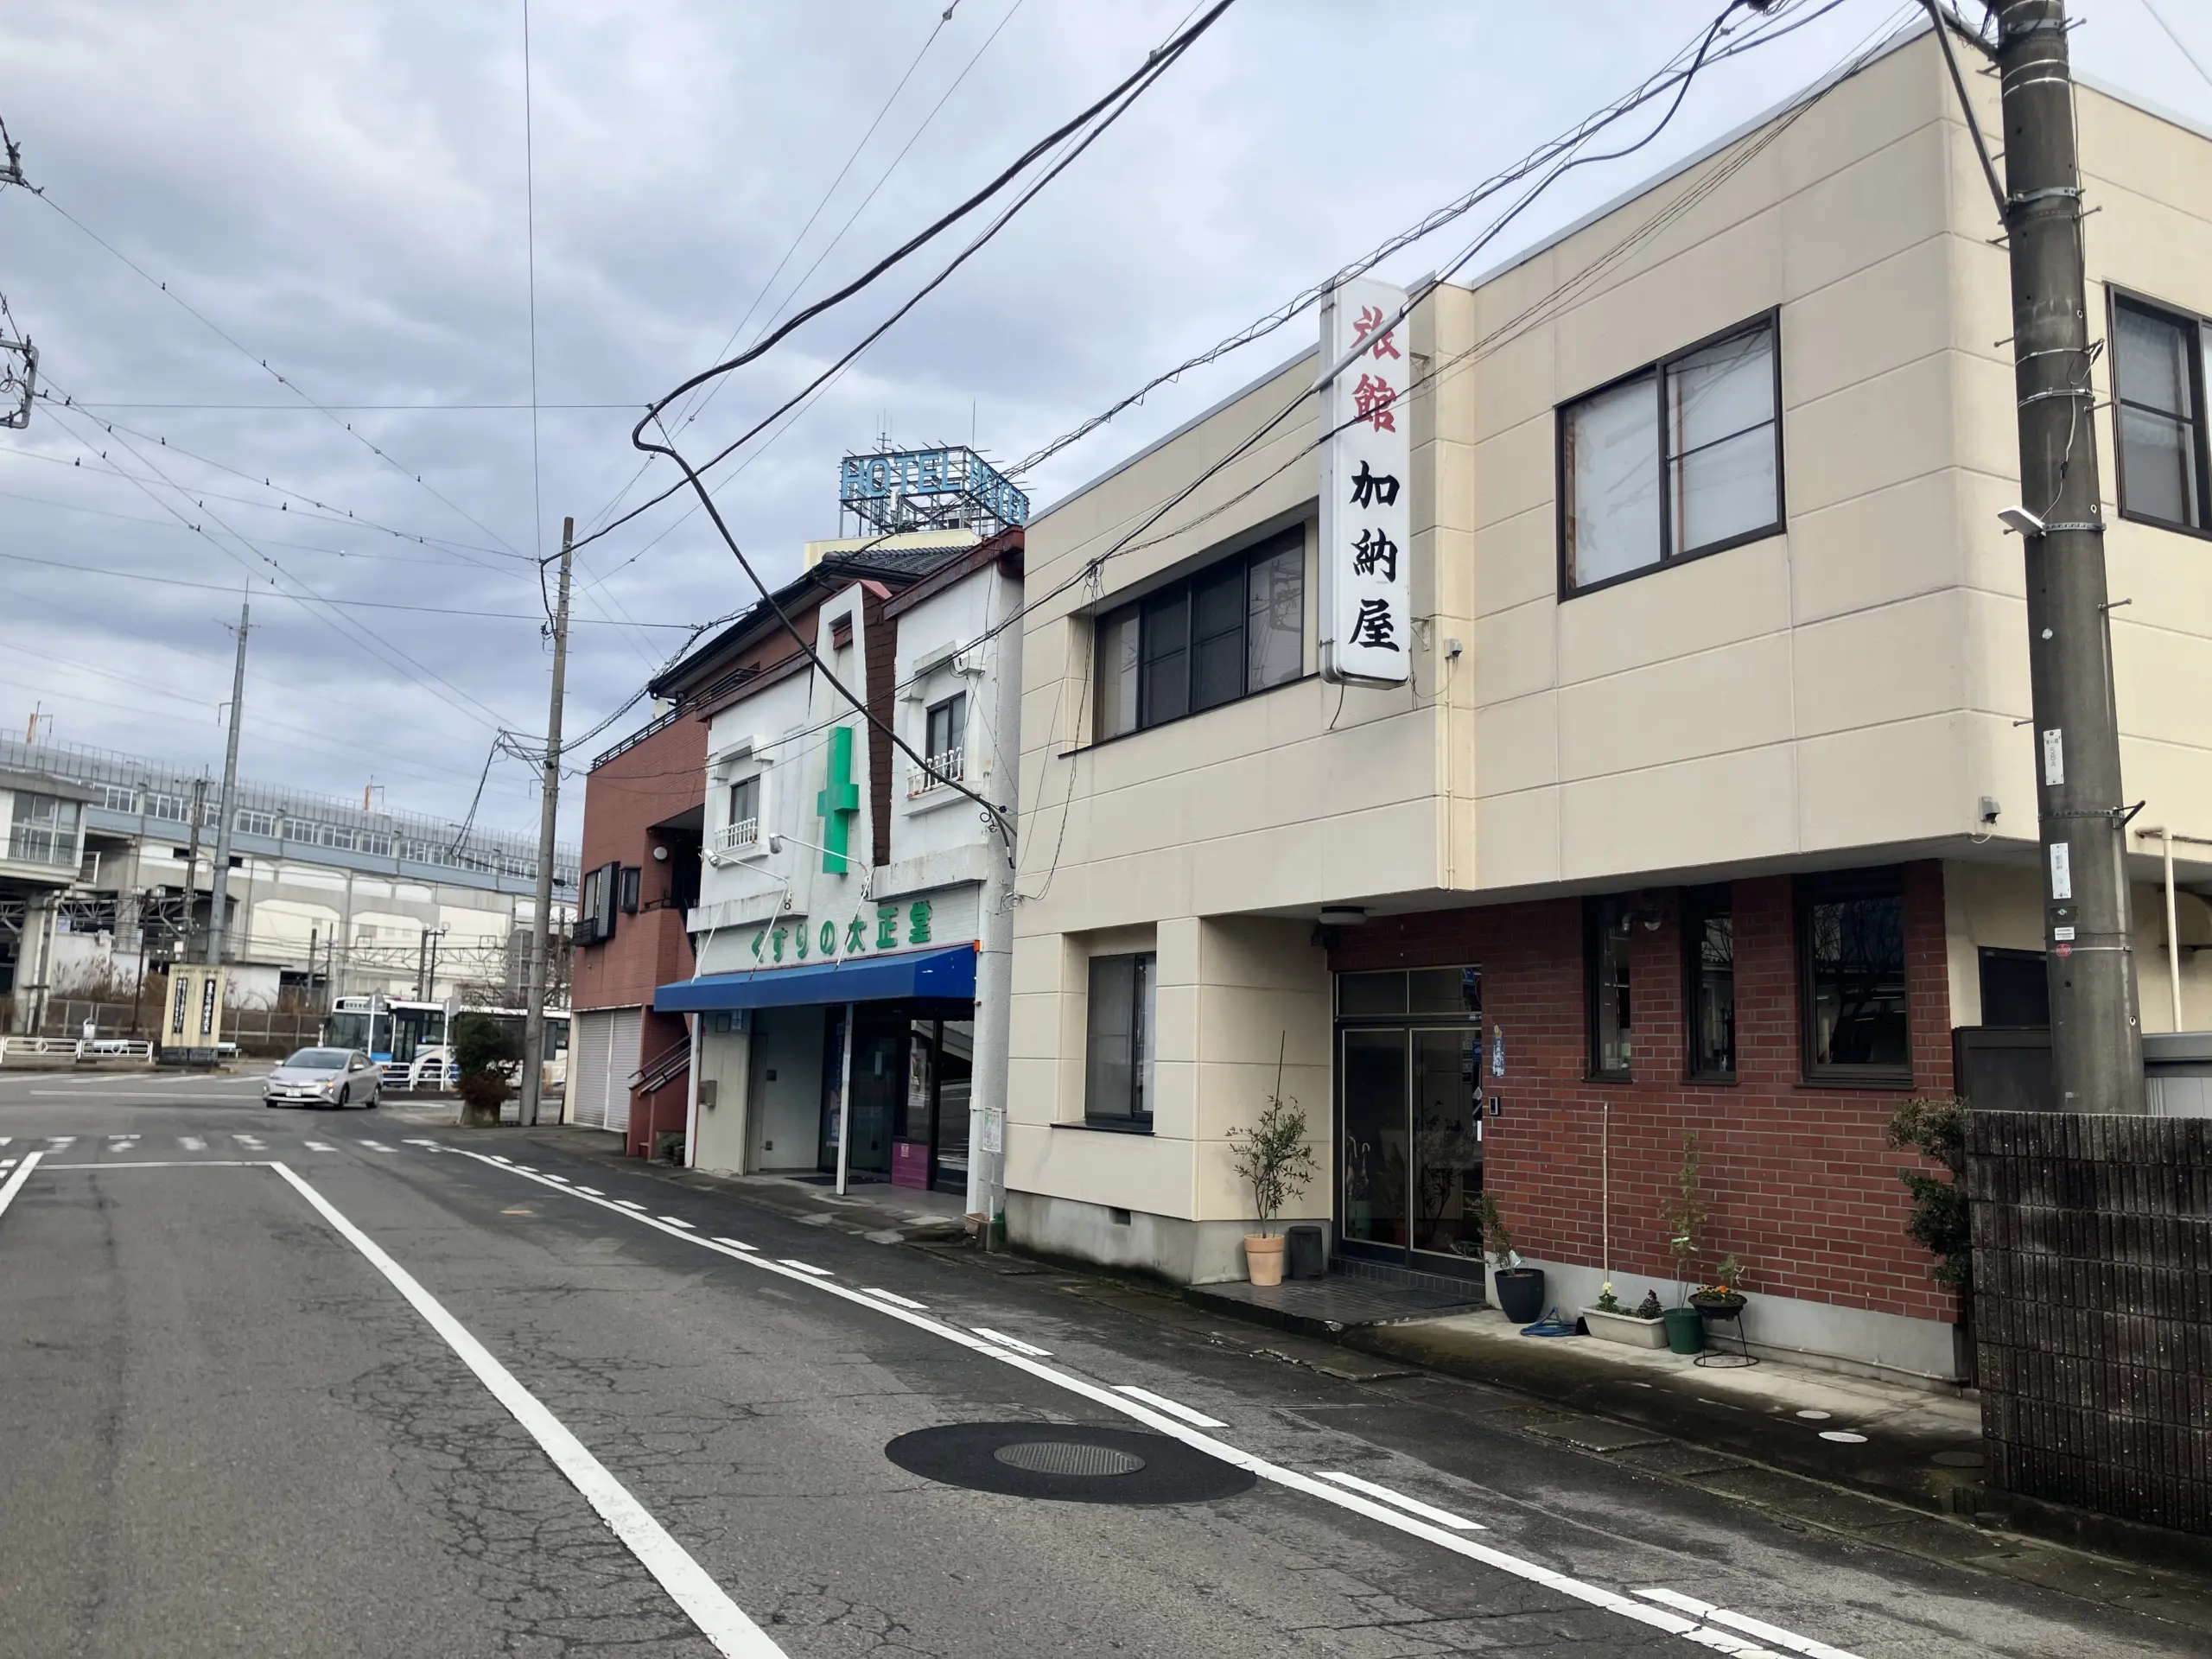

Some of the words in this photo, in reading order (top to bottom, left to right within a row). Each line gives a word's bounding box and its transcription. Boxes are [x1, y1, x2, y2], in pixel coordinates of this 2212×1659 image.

[1350, 305, 1402, 433] 旅館
[841, 451, 962, 500] HOTEL
[1348, 460, 1401, 652] 加納屋
[751, 900, 932, 963] くすりの大正堂
